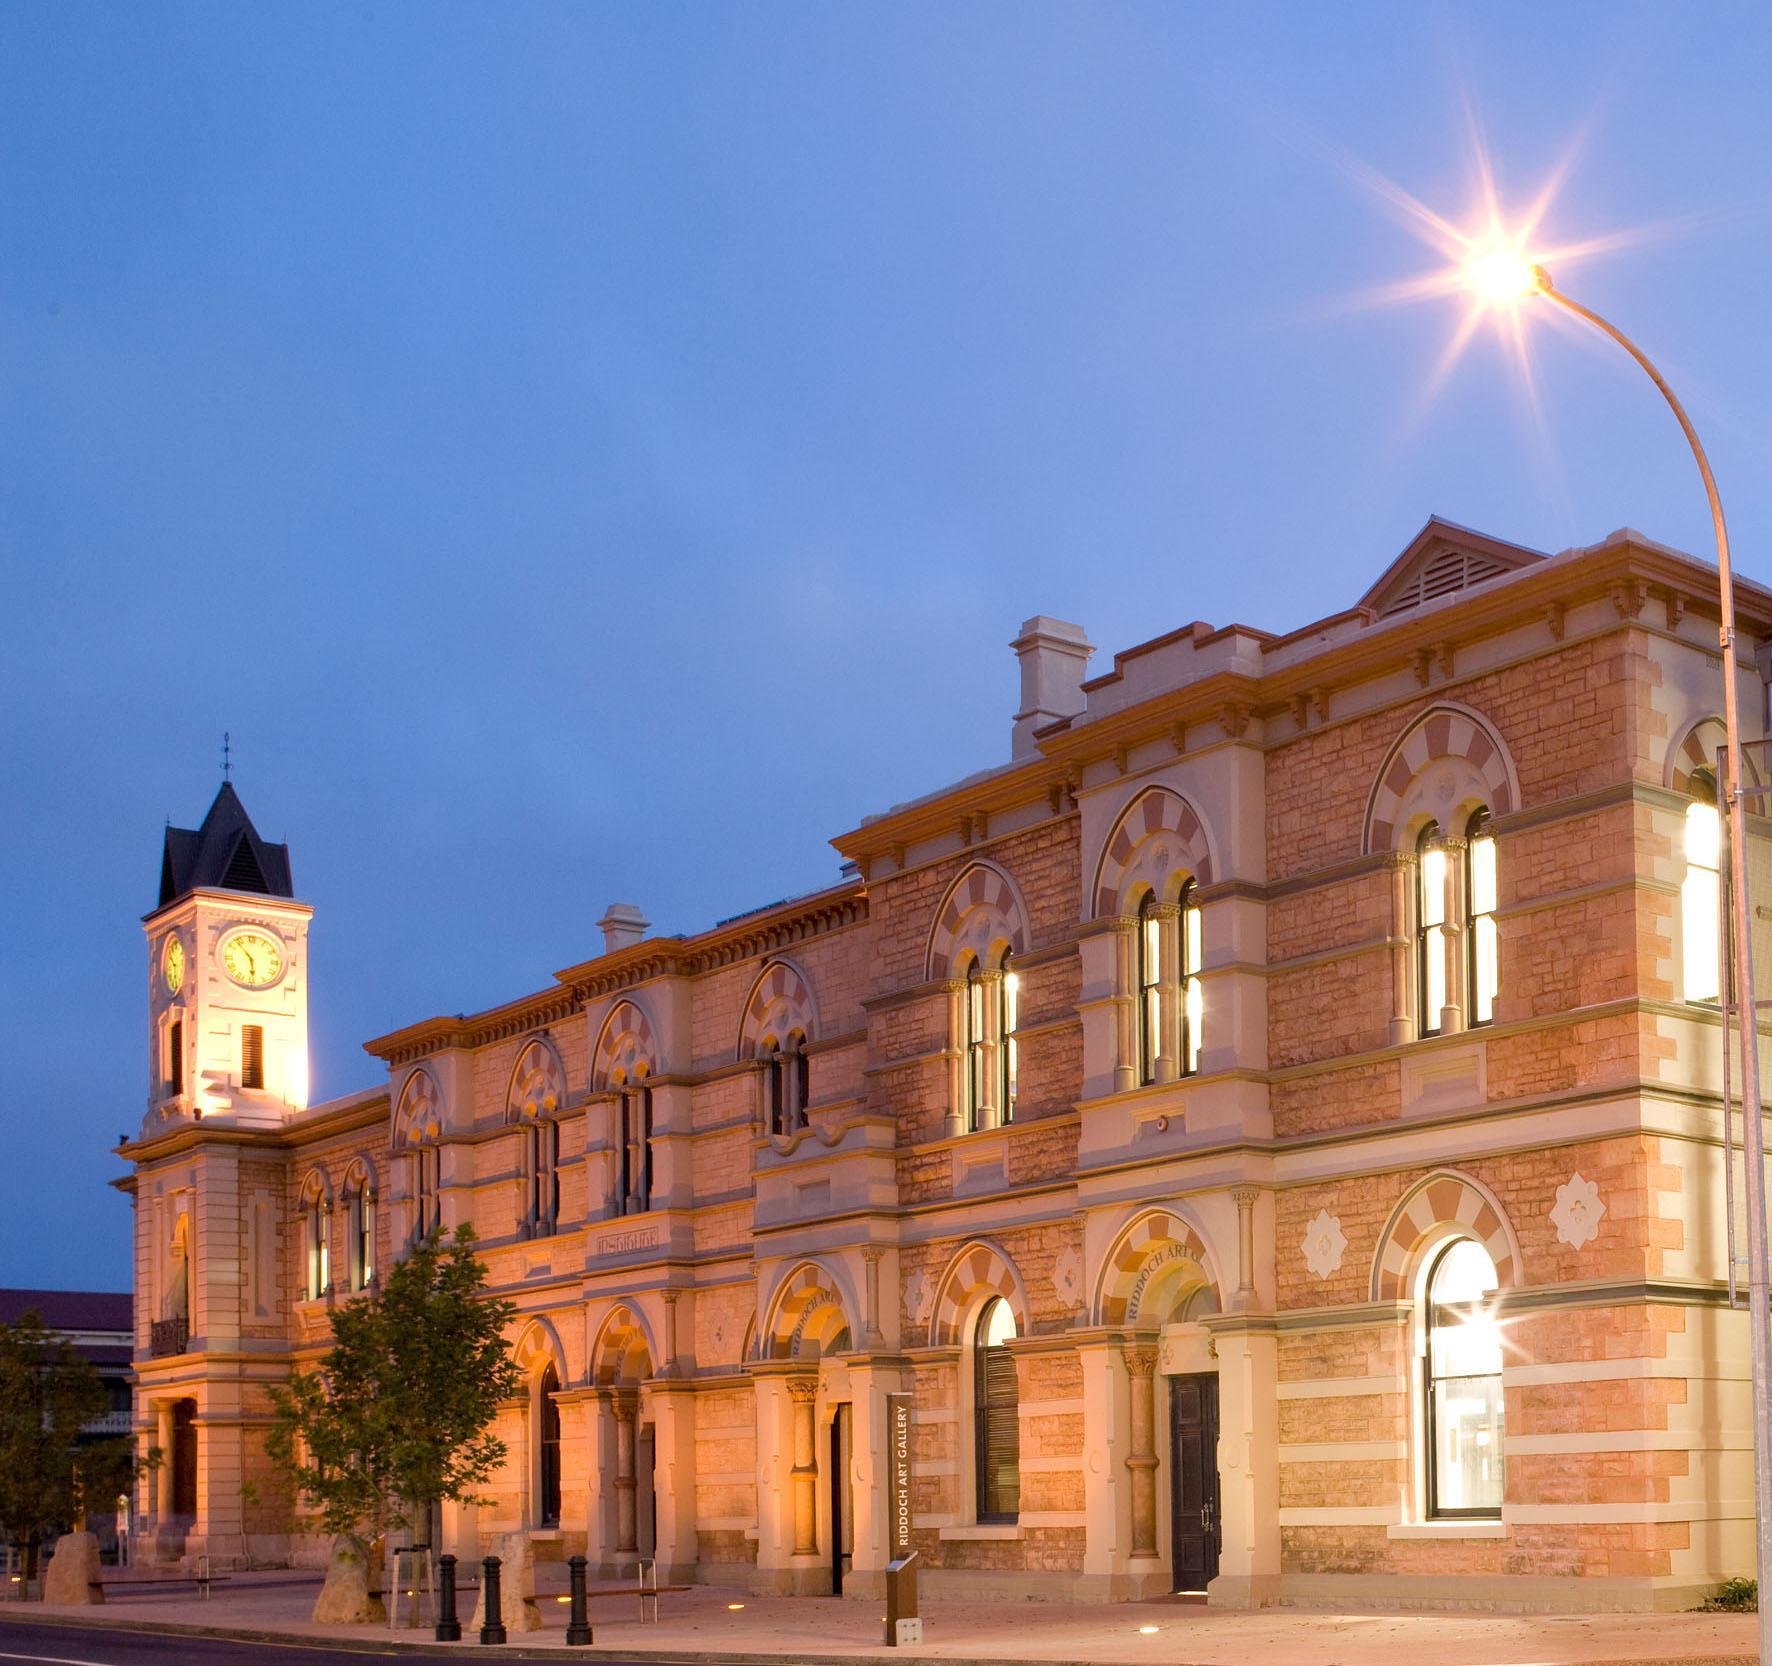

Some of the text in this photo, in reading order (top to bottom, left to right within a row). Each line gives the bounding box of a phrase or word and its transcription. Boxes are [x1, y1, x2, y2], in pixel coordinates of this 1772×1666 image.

[1128, 1250, 1164, 1321] RIDDOCH
[897, 1405, 909, 1546] RIDDOCH ART GALLERY
